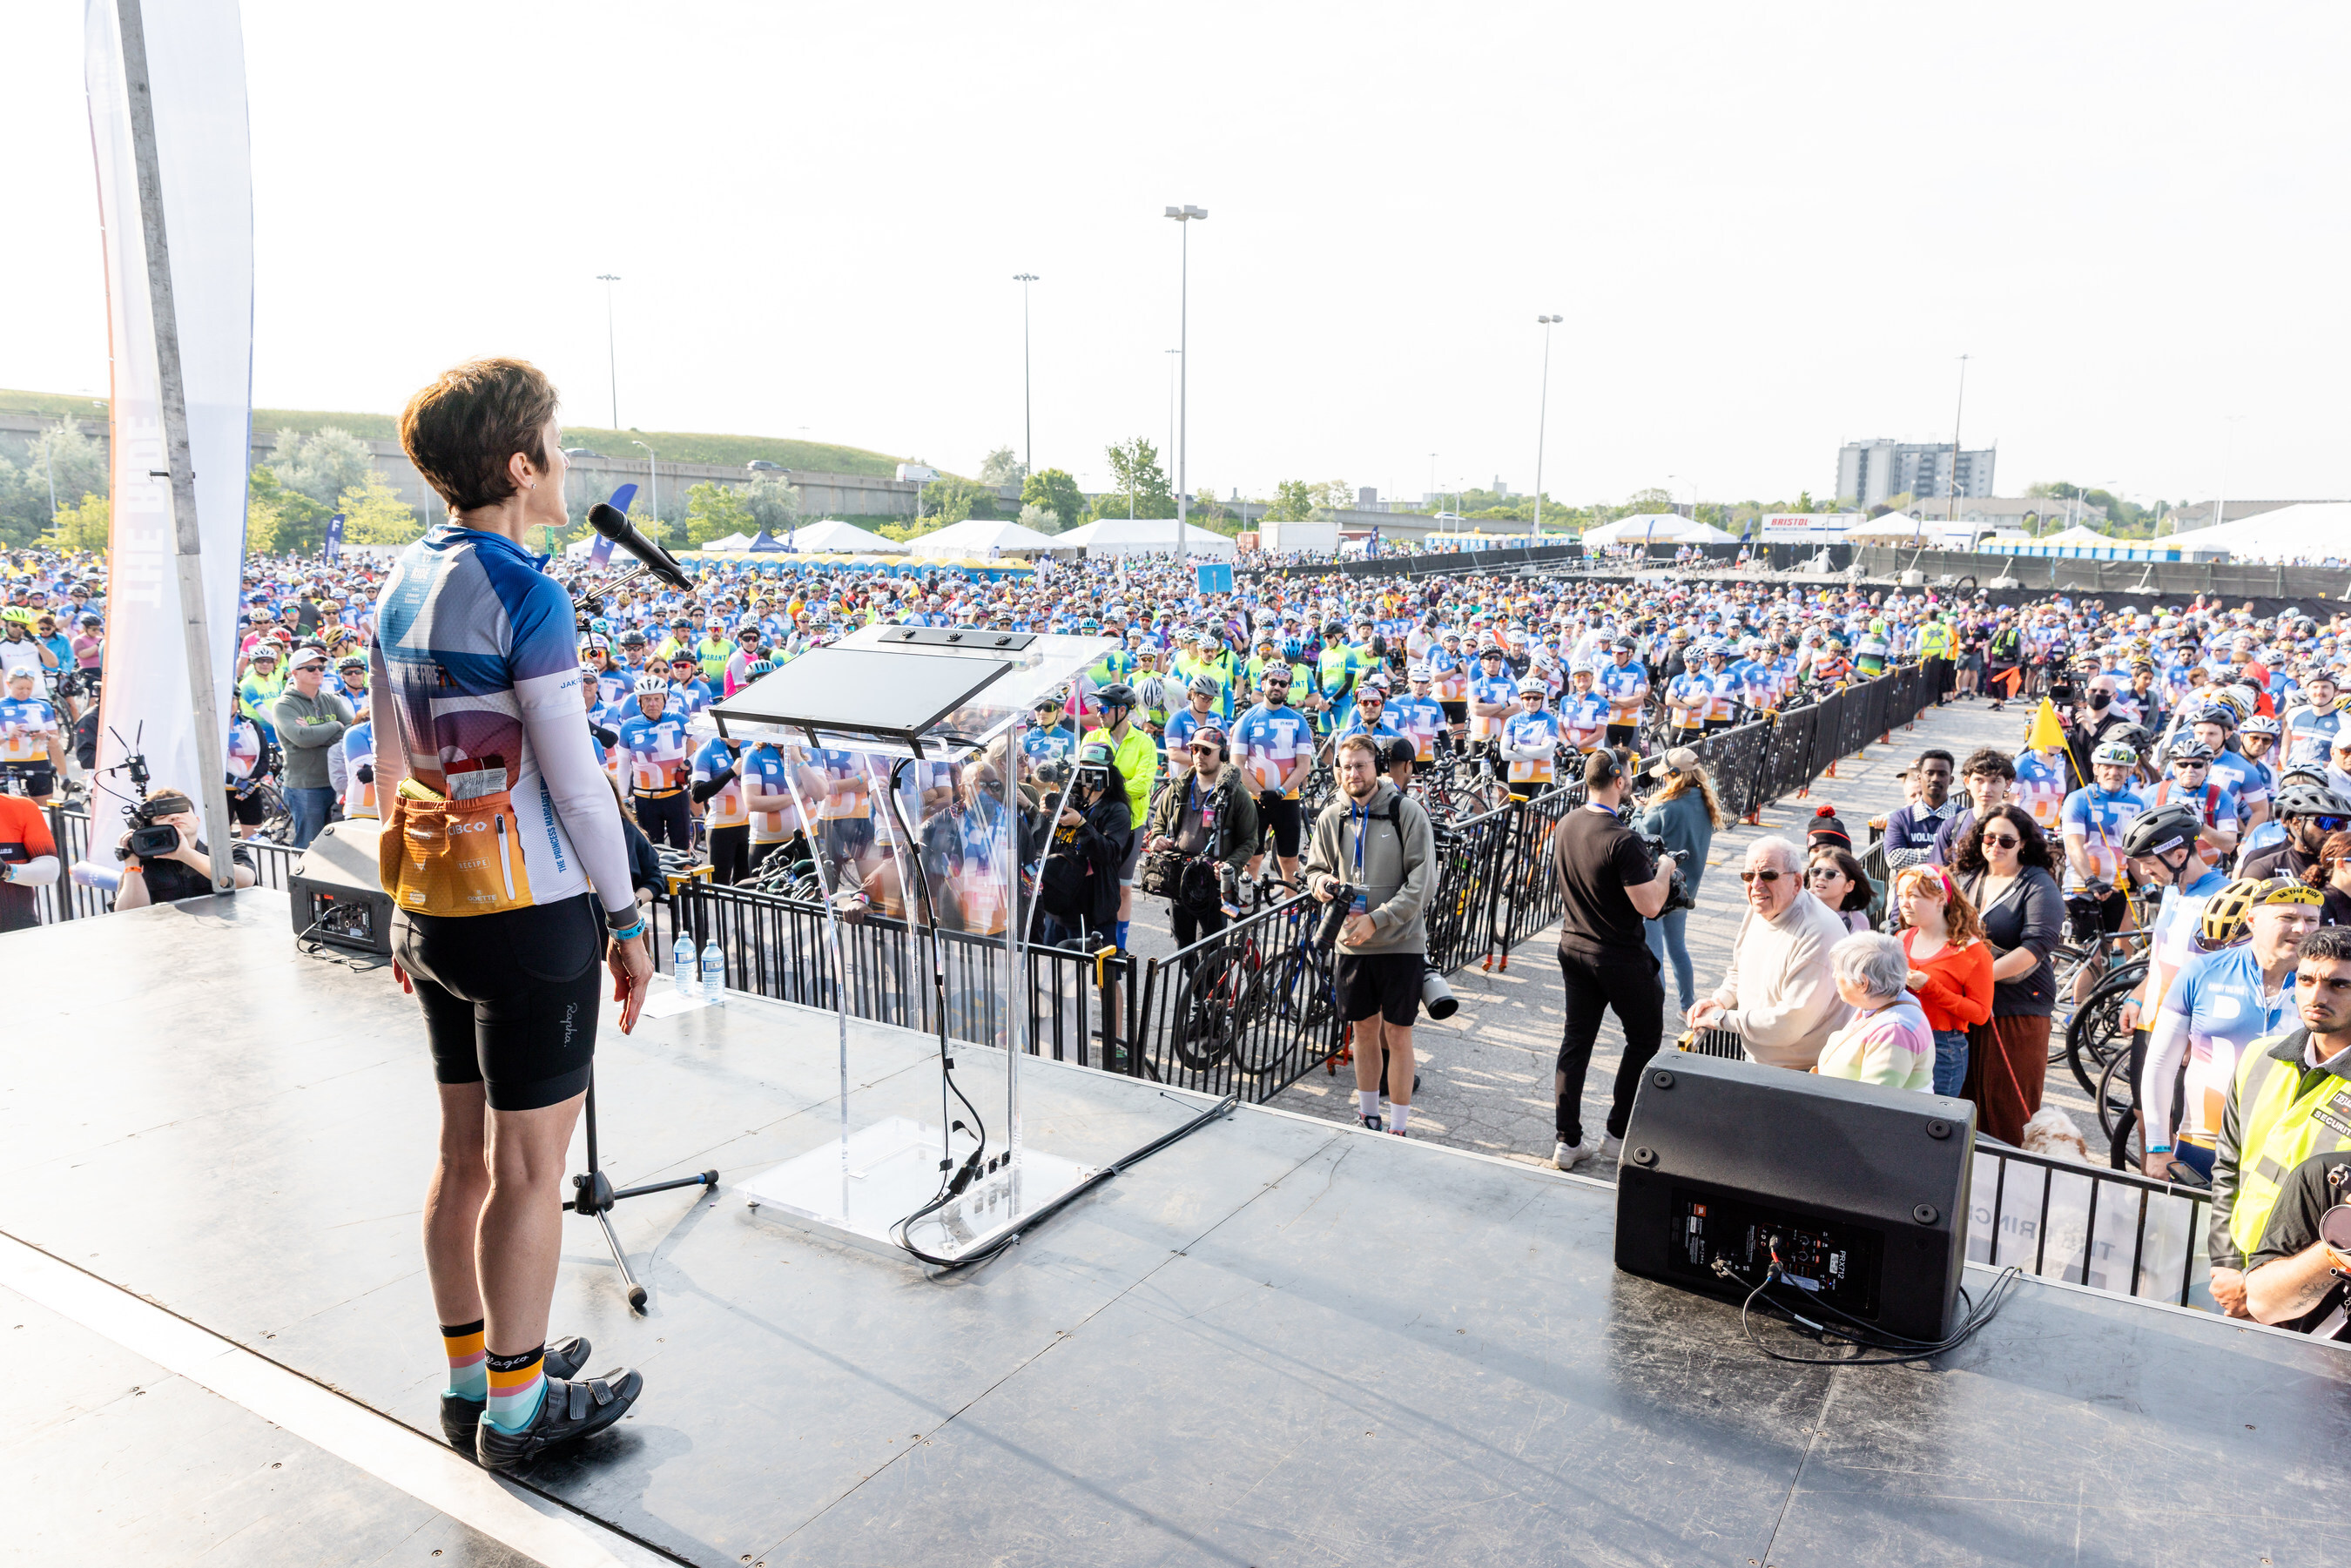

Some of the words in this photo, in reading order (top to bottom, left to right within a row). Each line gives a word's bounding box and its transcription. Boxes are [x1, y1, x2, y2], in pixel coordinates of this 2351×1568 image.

[541, 791, 555, 826] MARGARET
[448, 823, 473, 836] CIBC
[548, 826, 563, 859] PRINCESS
[459, 858, 488, 870] RECIPE
[556, 859, 567, 873] THE
[2314, 1110, 2351, 1137] SECURIT
[1837, 1249, 1847, 1280] PRX712
